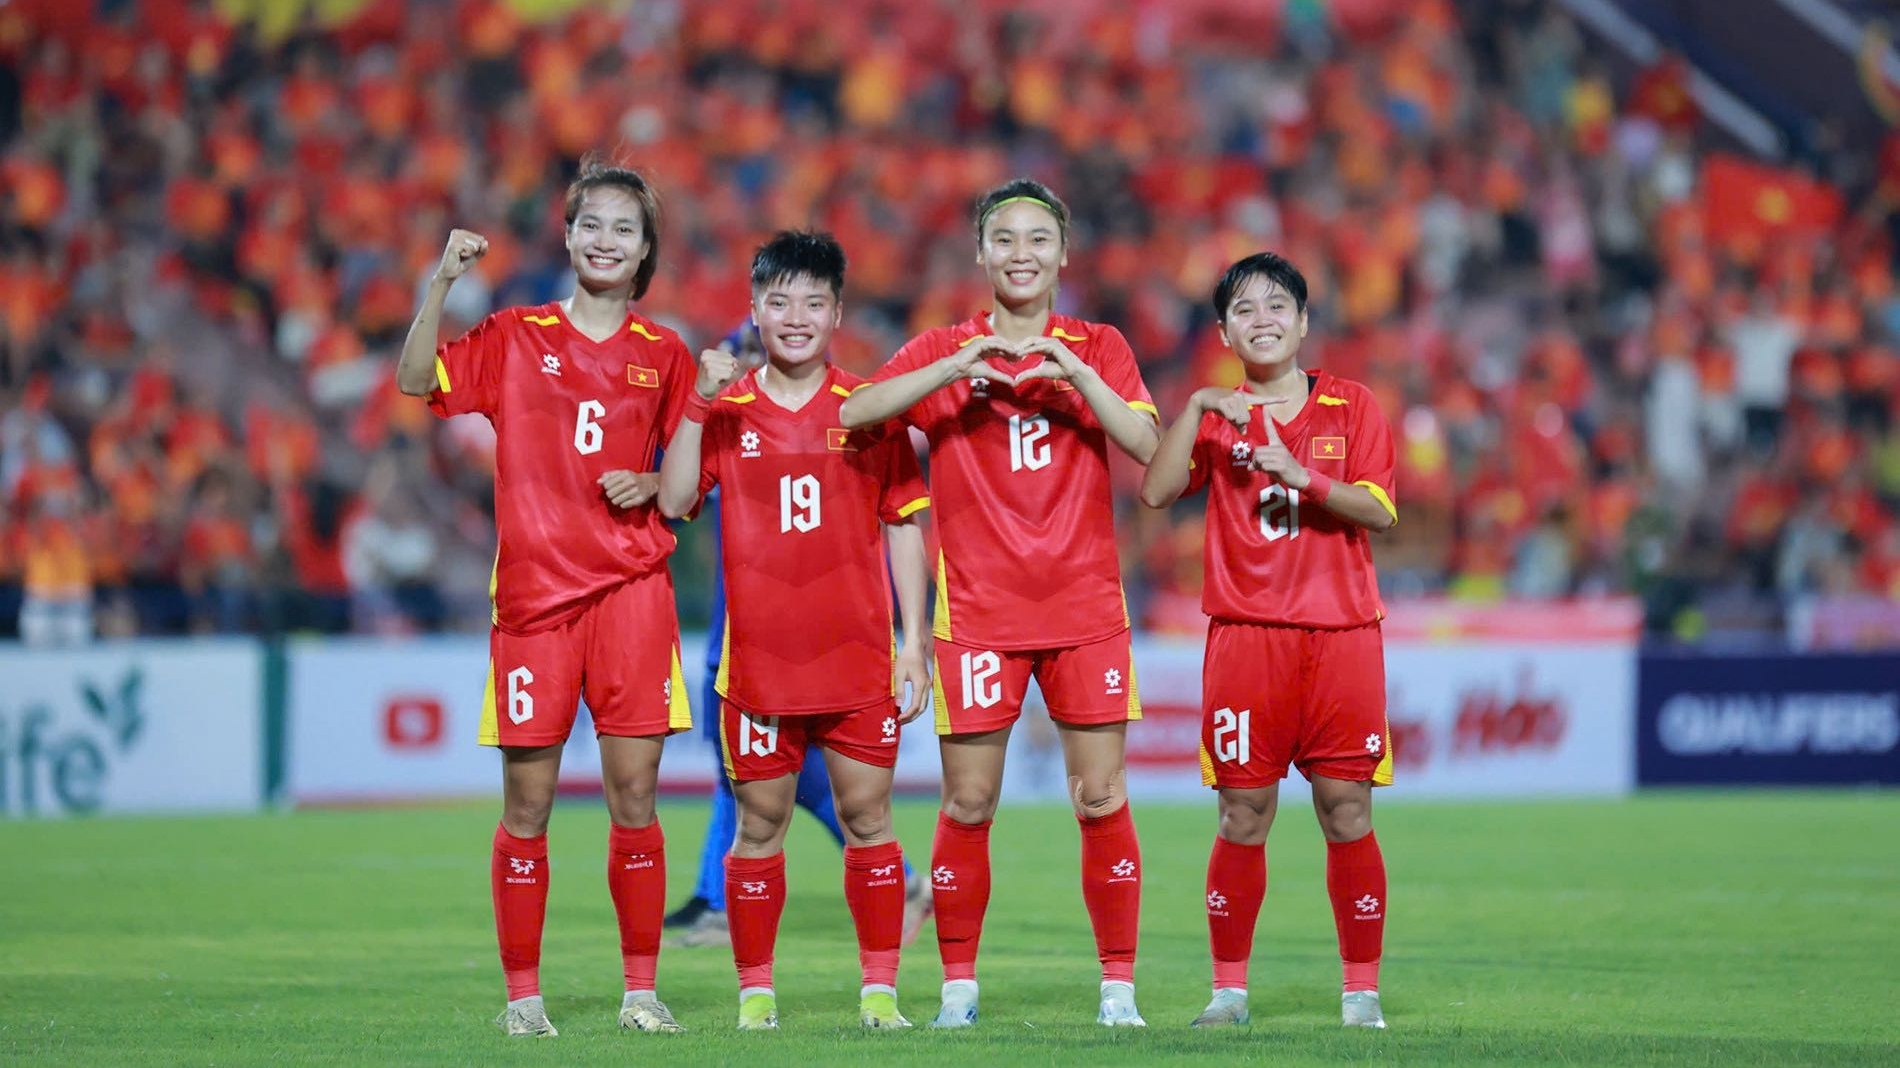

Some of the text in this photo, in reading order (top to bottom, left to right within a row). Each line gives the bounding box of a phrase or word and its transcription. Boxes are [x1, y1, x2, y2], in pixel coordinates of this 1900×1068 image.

[574, 399, 606, 455] 6
[1009, 413, 1052, 473] 12
[779, 473, 821, 534] 19
[1259, 483, 1299, 542] 21
[507, 665, 534, 726] 6
[960, 650, 1002, 710] 12
[739, 710, 779, 758] 19
[1213, 706, 1250, 766] 21
